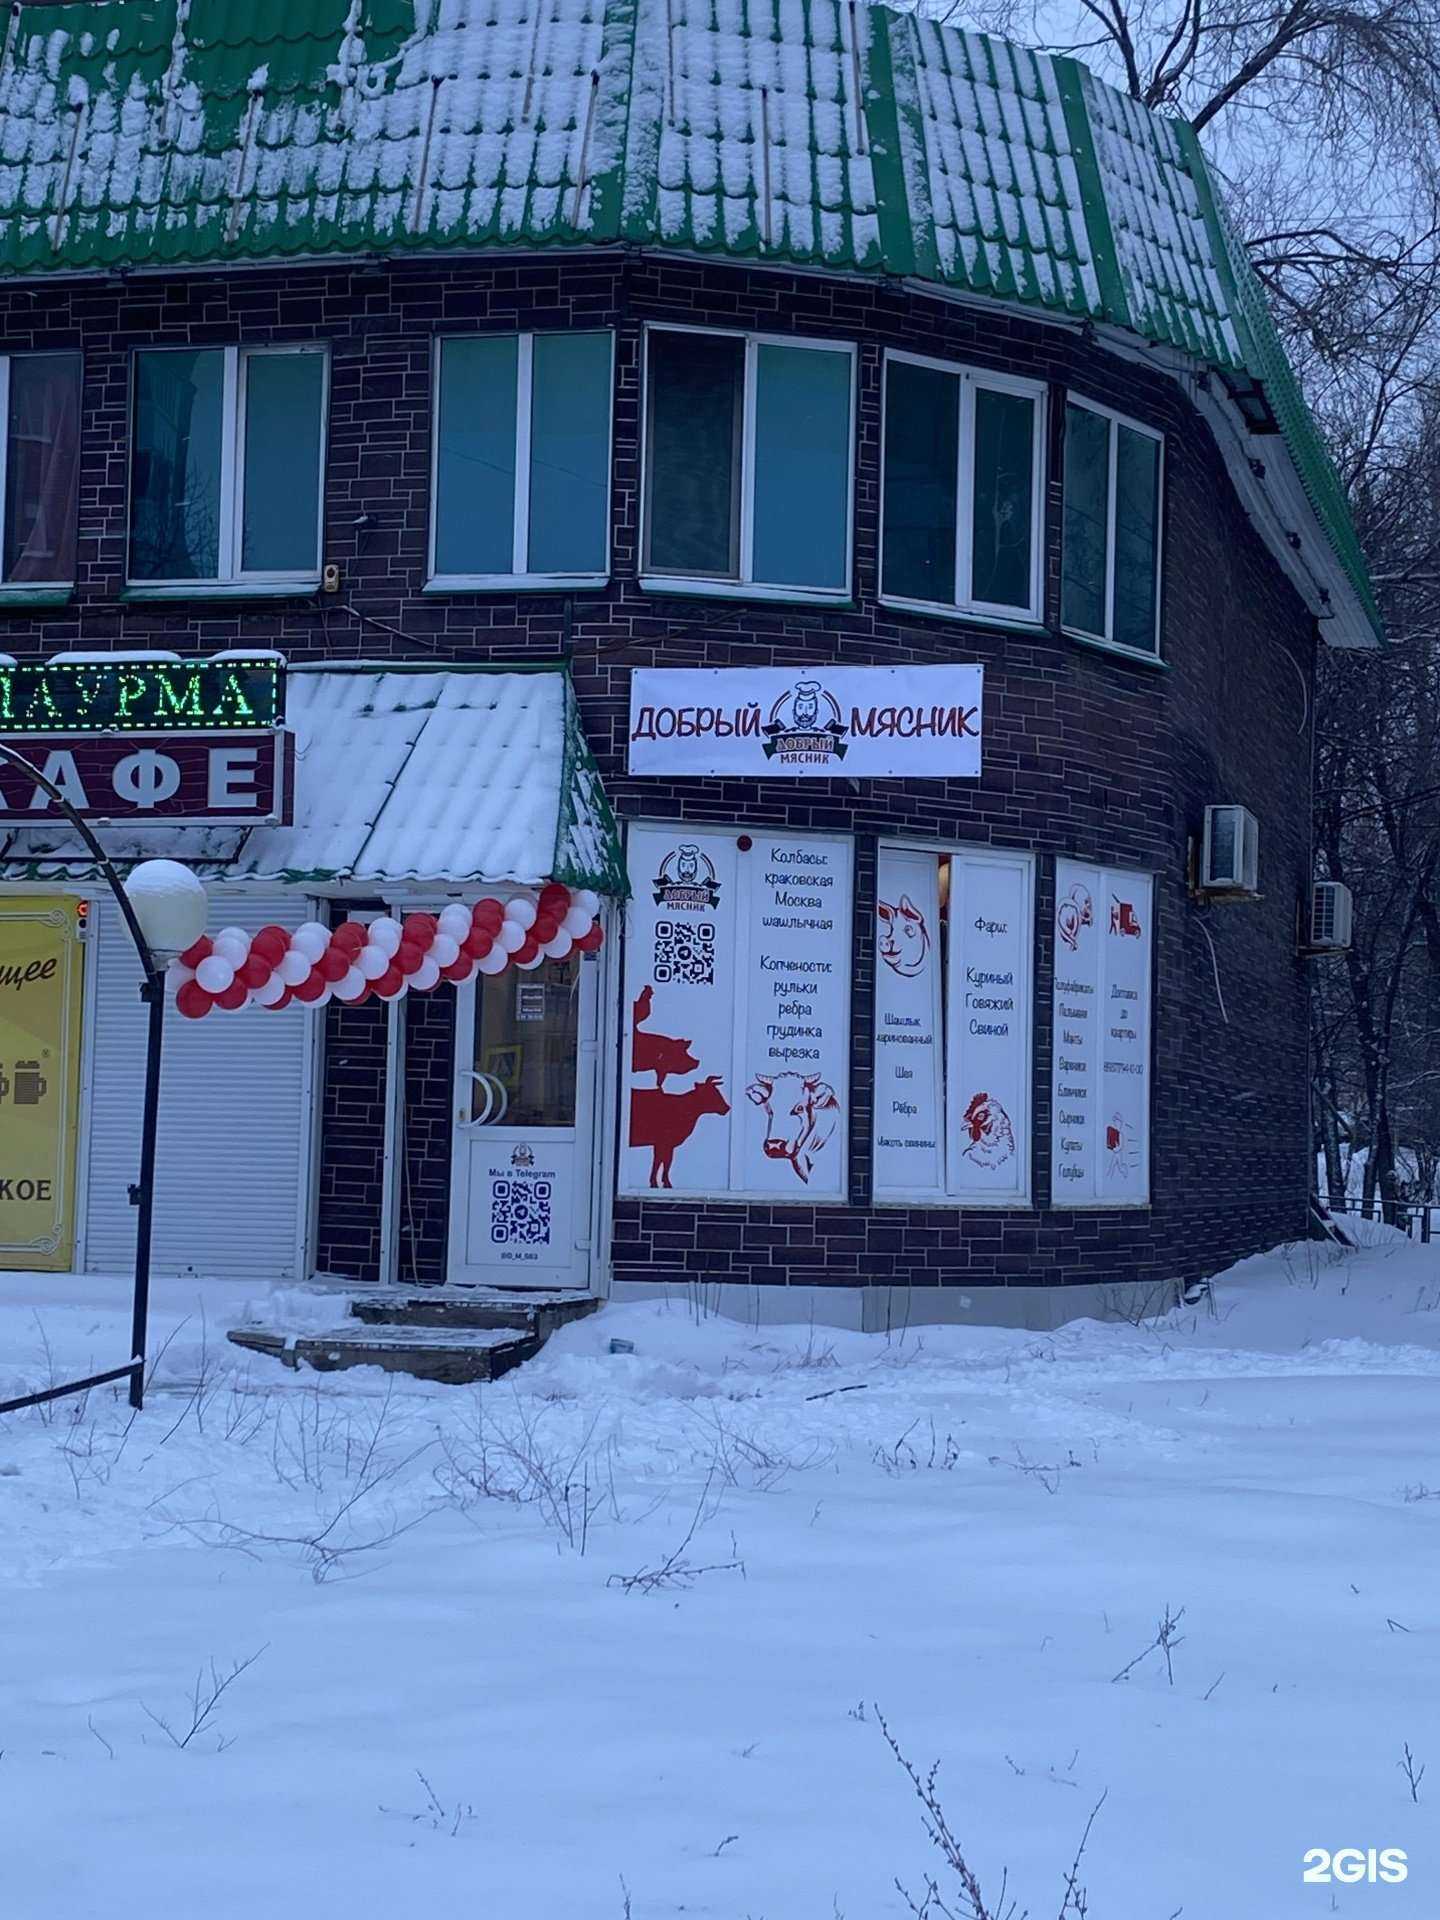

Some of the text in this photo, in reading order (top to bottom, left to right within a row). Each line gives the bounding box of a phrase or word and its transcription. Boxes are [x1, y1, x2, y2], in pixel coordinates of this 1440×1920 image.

[631, 702, 980, 741] ДОБРЫЙ МЯСНИК
[775, 735, 834, 752] ДОБРЫЙ
[780, 753, 830, 764] МЯСНИК
[764, 873, 833, 887] краковская
[775, 891, 822, 908] Москва
[762, 917, 833, 930] шашлычная
[967, 966, 1013, 988] Куриный
[774, 981, 818, 997] рульки
[778, 1000, 812, 1019] ребра
[965, 993, 1014, 1010] Говяжий
[767, 1025, 823, 1040] грудинка
[969, 1018, 1009, 1036] Свиной
[768, 1047, 820, 1062] вырезка
[516, 1169, 556, 1179] Telegram
